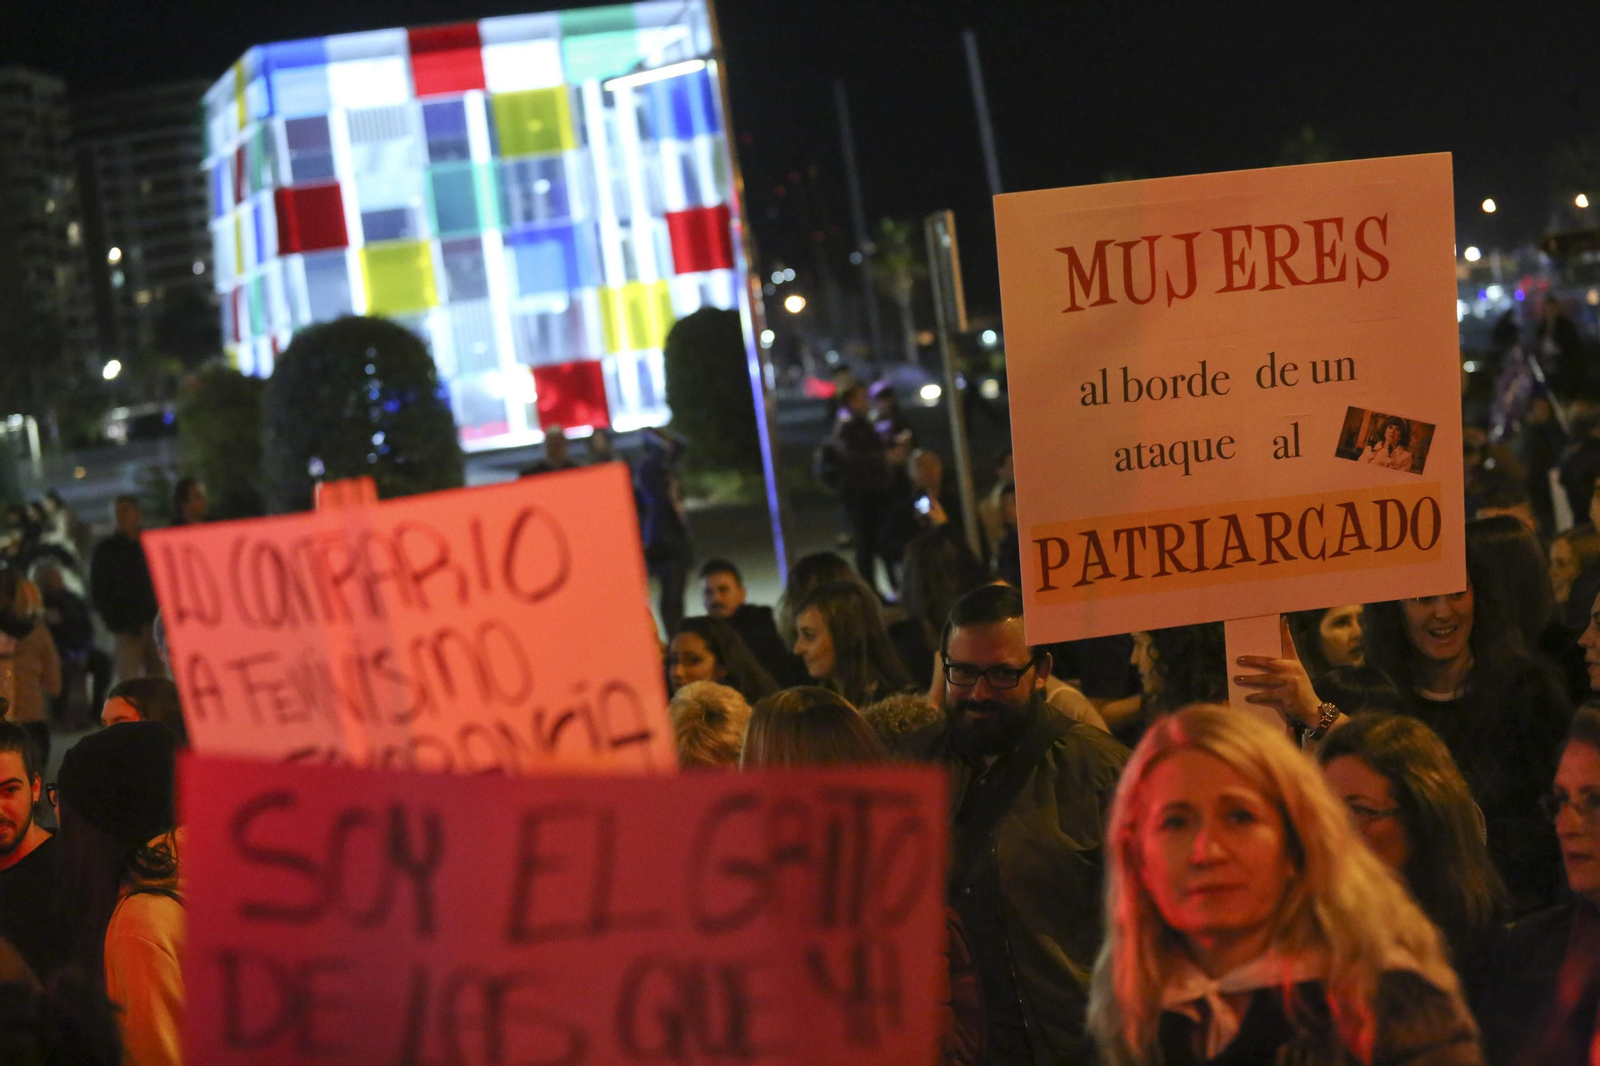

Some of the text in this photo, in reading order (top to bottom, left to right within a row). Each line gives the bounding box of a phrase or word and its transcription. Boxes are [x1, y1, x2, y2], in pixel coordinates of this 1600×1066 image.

[1055, 212, 1390, 314] MUJERES
[1080, 352, 1358, 407] al borde de un
[1114, 422, 1303, 477] ataque al
[229, 503, 573, 631] CONTRARIO
[1032, 496, 1442, 593] PATRIARCADO
[229, 791, 446, 941] SOY
[507, 797, 678, 944] EL
[215, 950, 361, 1059] DE
[614, 948, 796, 1062] QUE
